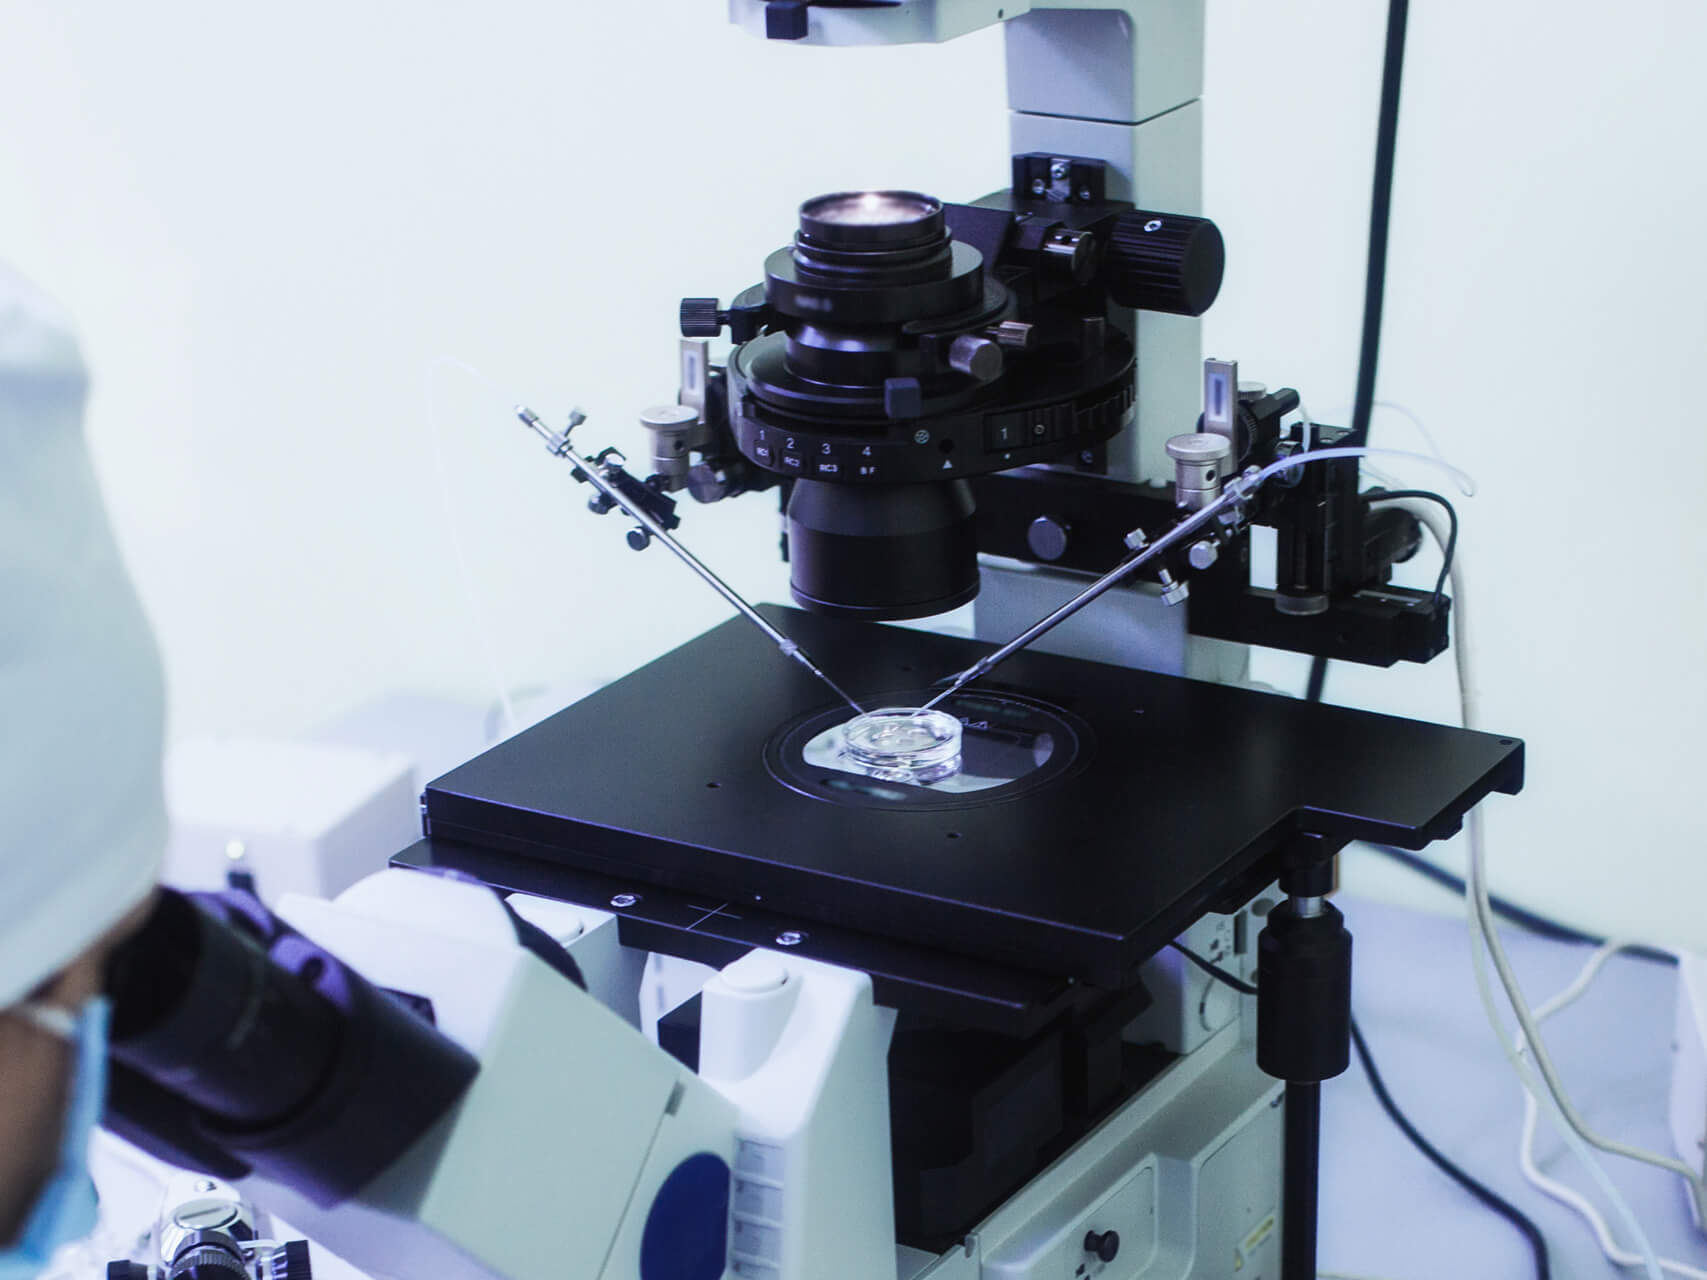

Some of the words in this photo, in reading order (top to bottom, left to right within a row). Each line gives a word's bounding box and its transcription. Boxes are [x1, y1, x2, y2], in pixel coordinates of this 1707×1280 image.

[1000, 427, 1008, 440] 1
[759, 429, 765, 440] 1
[786, 437, 795, 449] 2
[821, 442, 831, 455] 3
[862, 446, 872, 456] 4
[819, 463, 839, 473] RC3
